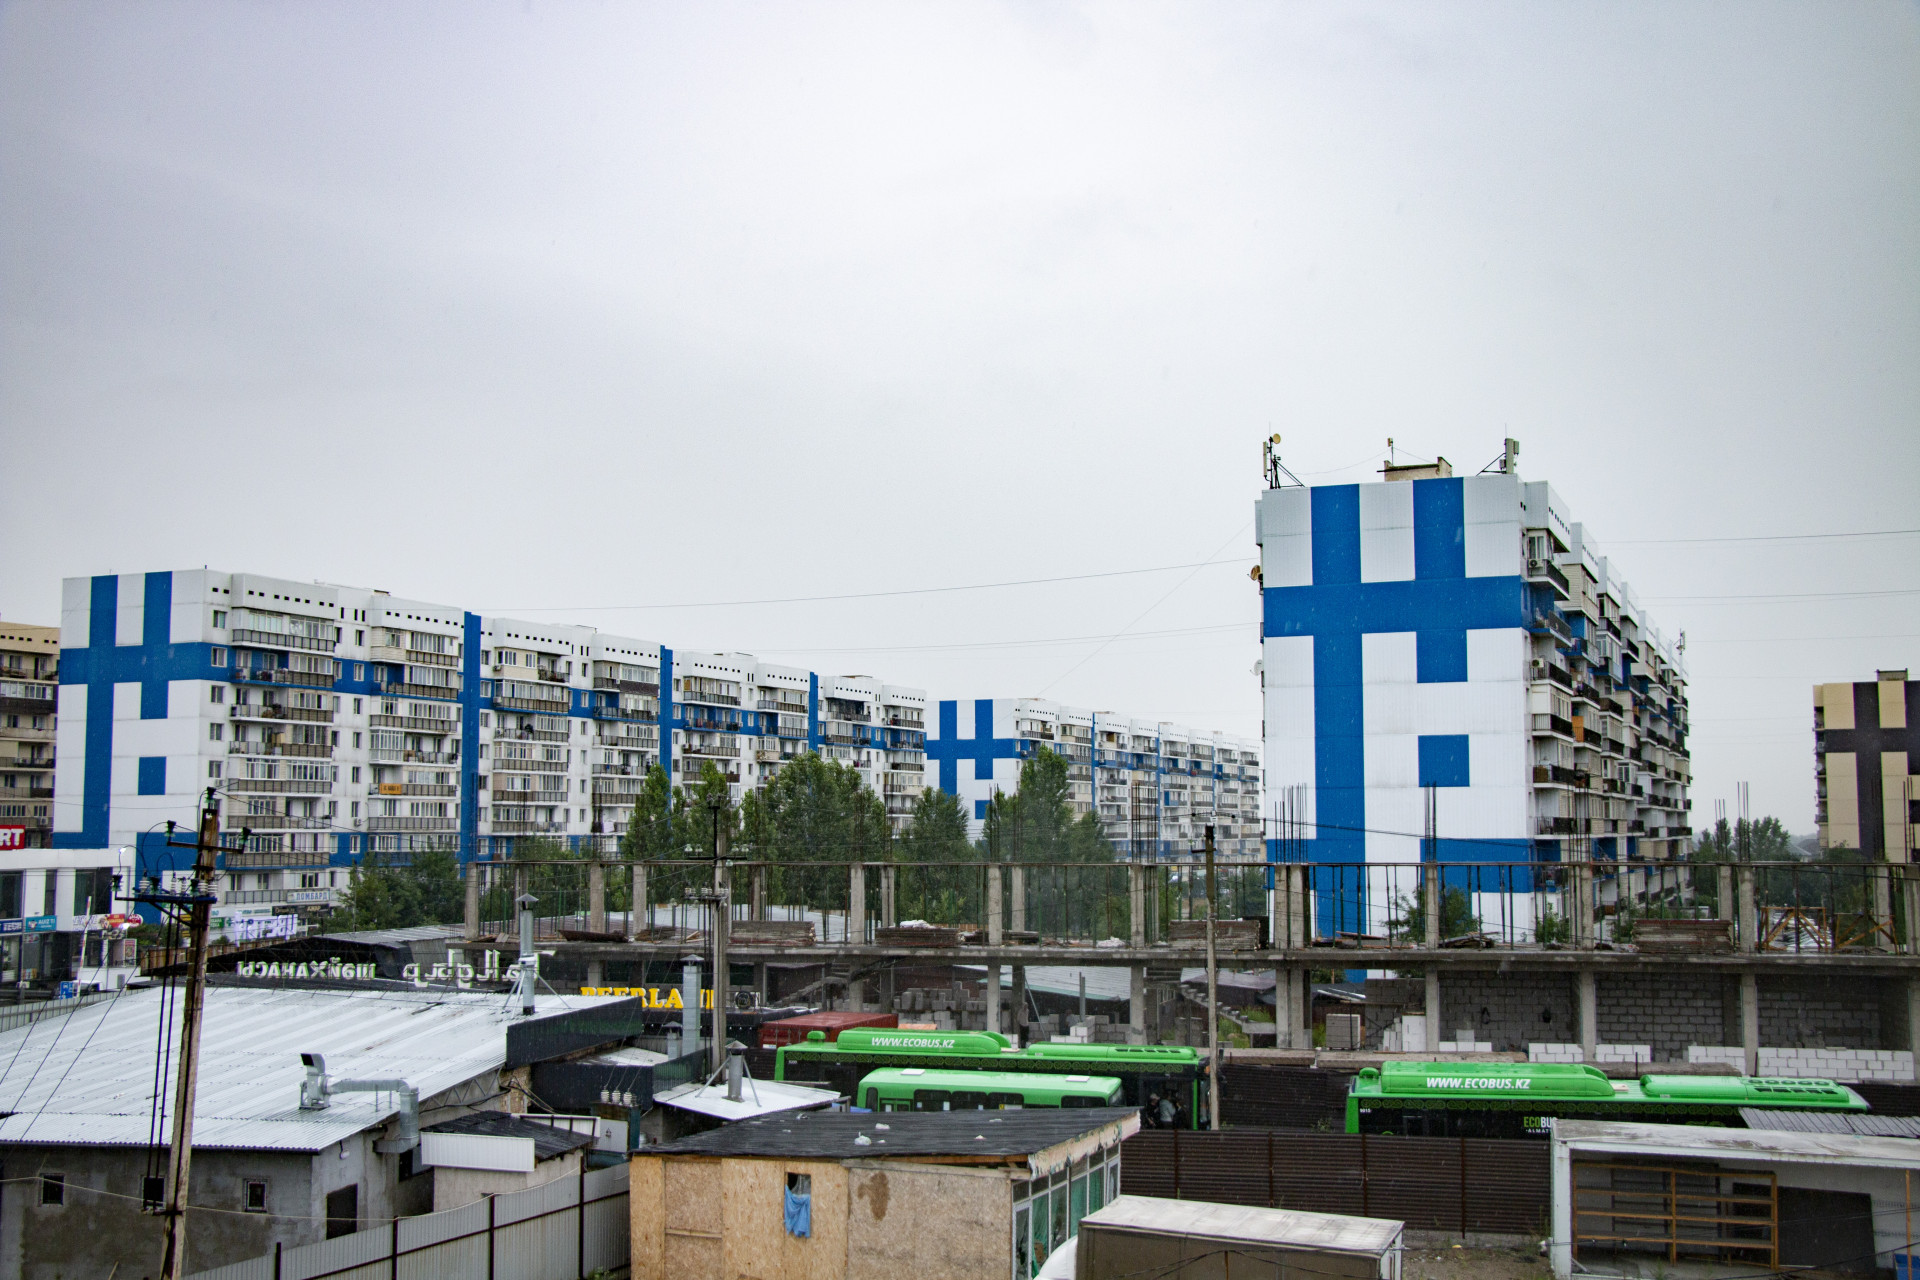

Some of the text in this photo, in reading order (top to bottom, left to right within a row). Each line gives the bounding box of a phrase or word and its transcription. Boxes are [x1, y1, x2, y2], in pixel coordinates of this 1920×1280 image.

[296, 892, 328, 900] ЛОМБАРД
[580, 986, 714, 1009] EERLA
[871, 1037, 955, 1048] WWW.ECOBUS.KZ
[1426, 1077, 1531, 1089] WWW.ECOBUS.KZ
